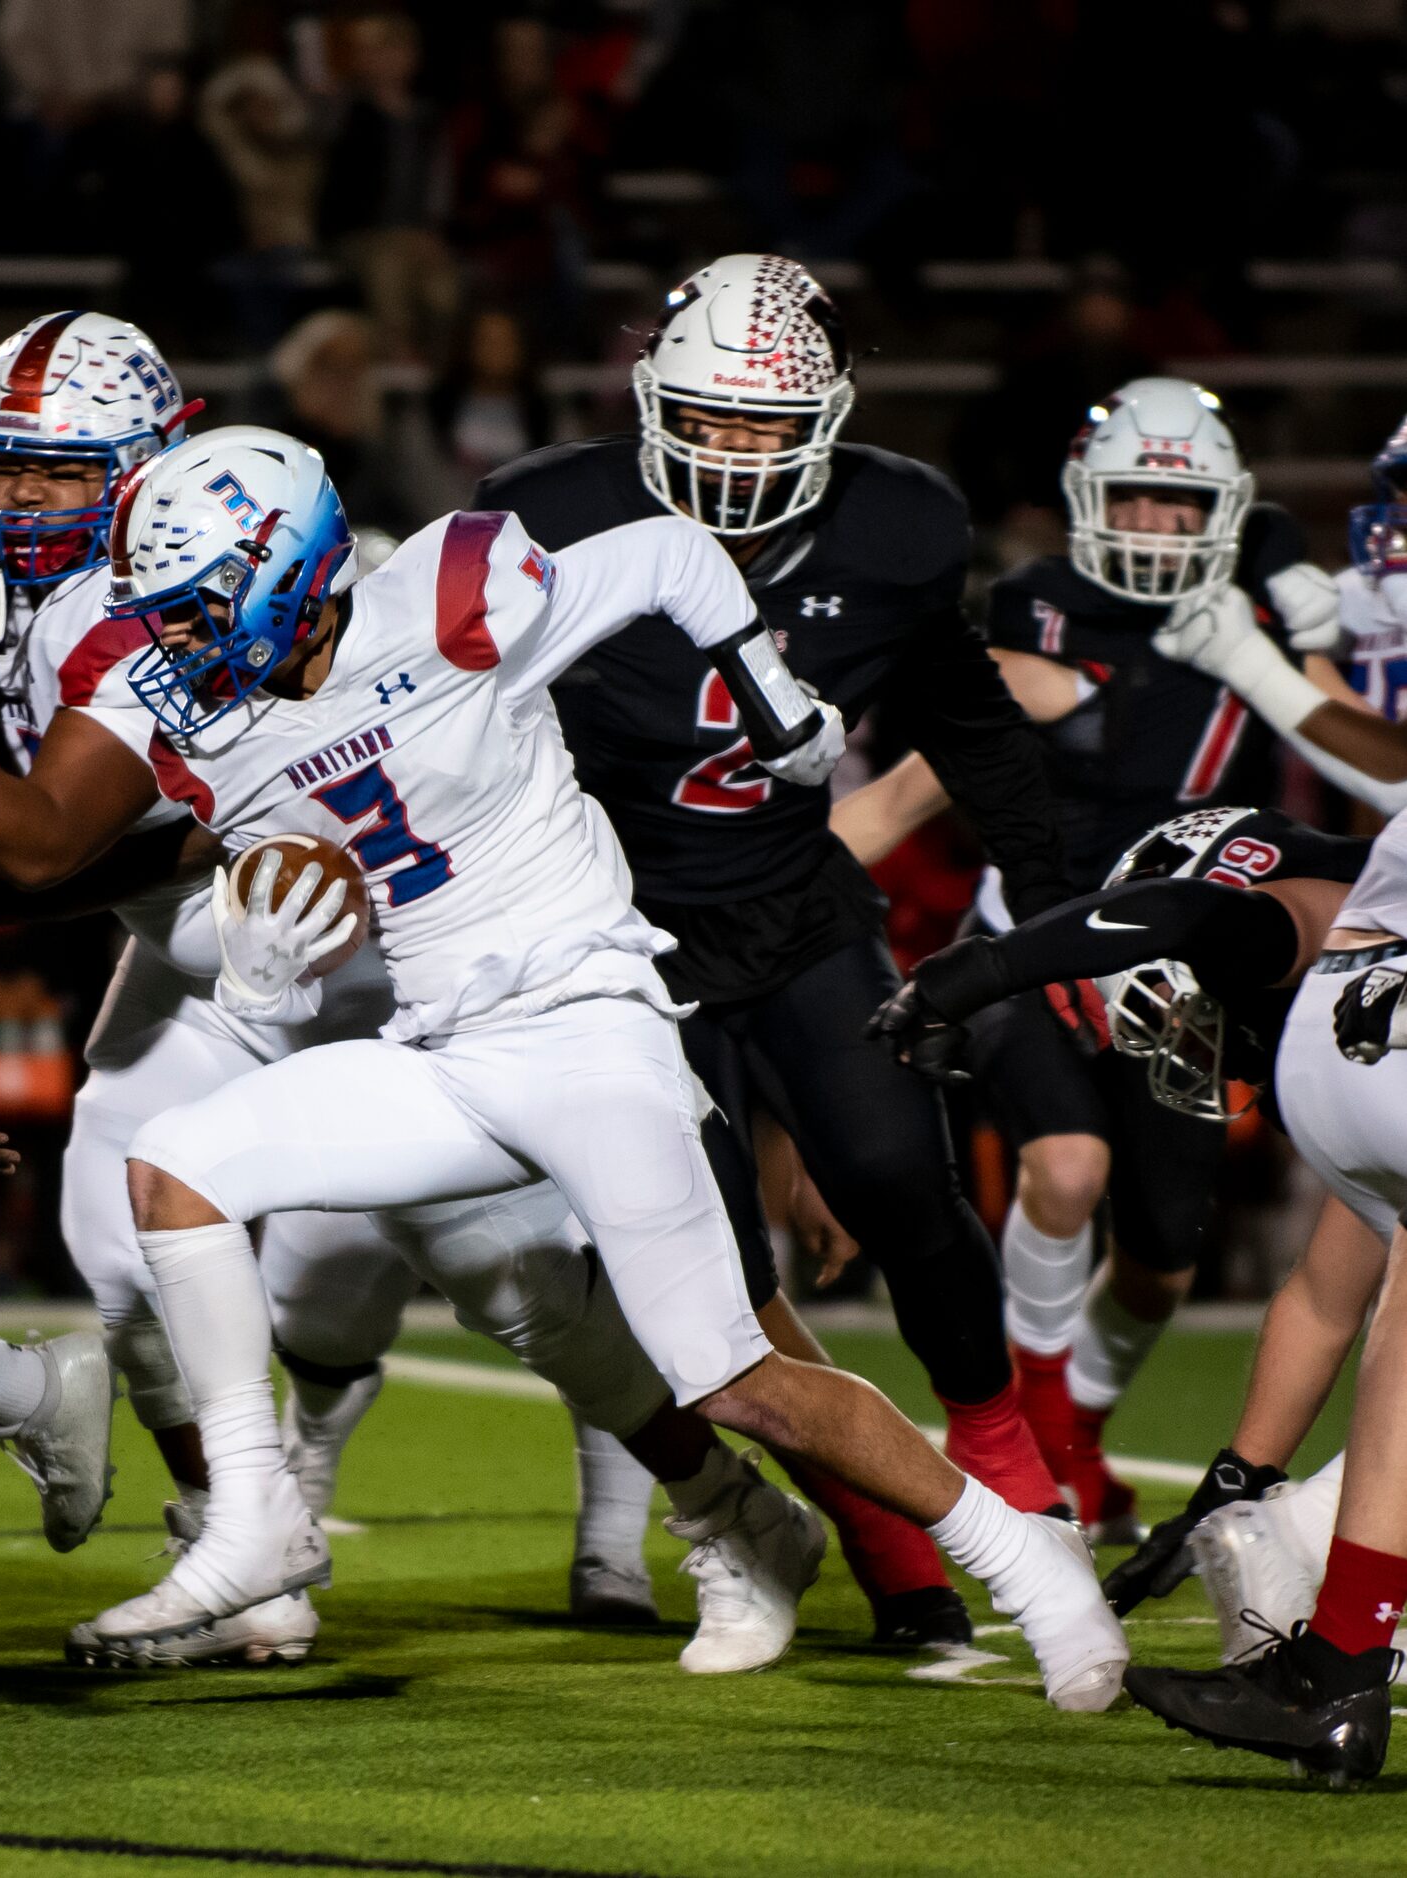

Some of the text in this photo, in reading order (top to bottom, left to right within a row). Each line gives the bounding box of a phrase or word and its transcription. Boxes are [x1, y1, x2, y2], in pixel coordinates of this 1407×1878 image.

[713, 372, 766, 390] Riddell
[202, 468, 268, 536] 3
[1031, 599, 1067, 654] 7
[671, 667, 773, 814] 2
[307, 759, 457, 909] 3
